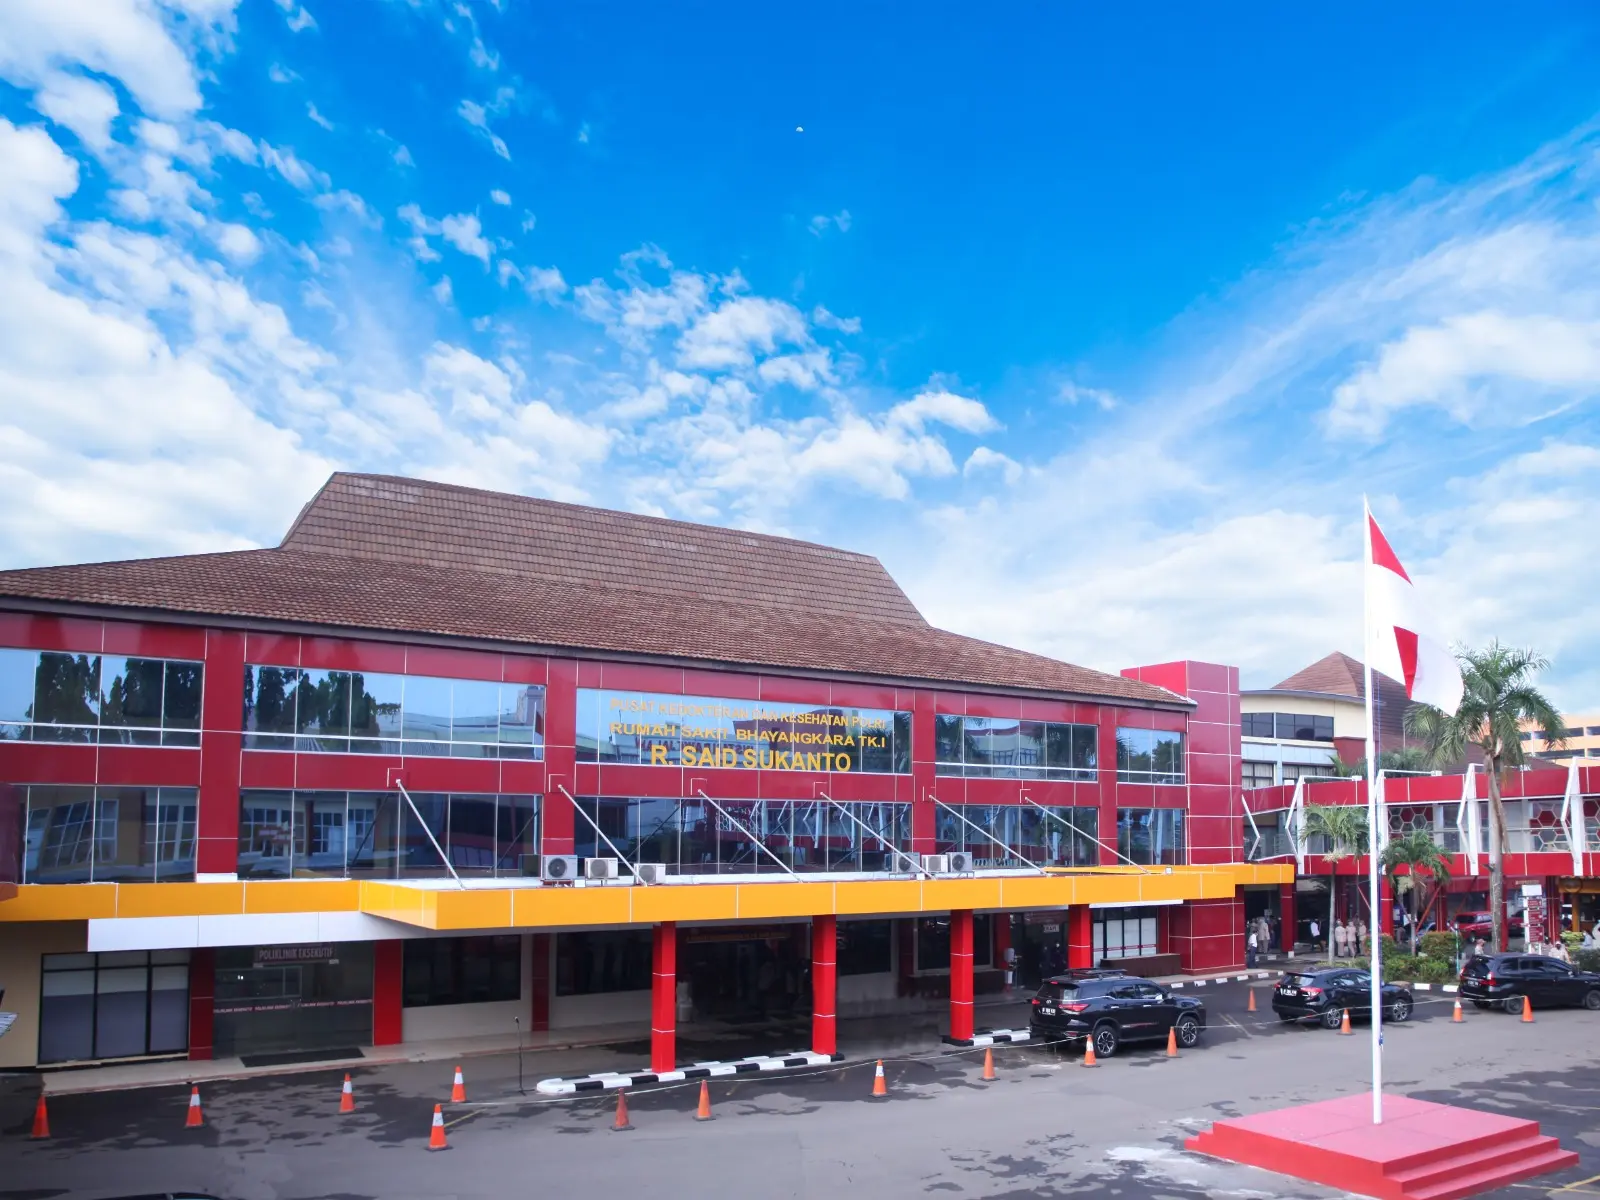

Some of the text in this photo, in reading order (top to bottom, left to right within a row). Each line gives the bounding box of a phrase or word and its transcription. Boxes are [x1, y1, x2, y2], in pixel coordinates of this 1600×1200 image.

[610, 699, 886, 729] PUSAT KEDOKTERAN DAN KESEHATAN POLRI
[610, 722, 887, 748] RUMAH SAKIT BHAYANGKARA TK.I
[650, 744, 674, 766] R.
[682, 745, 737, 768] SAID
[743, 749, 851, 772] SUKANTO
